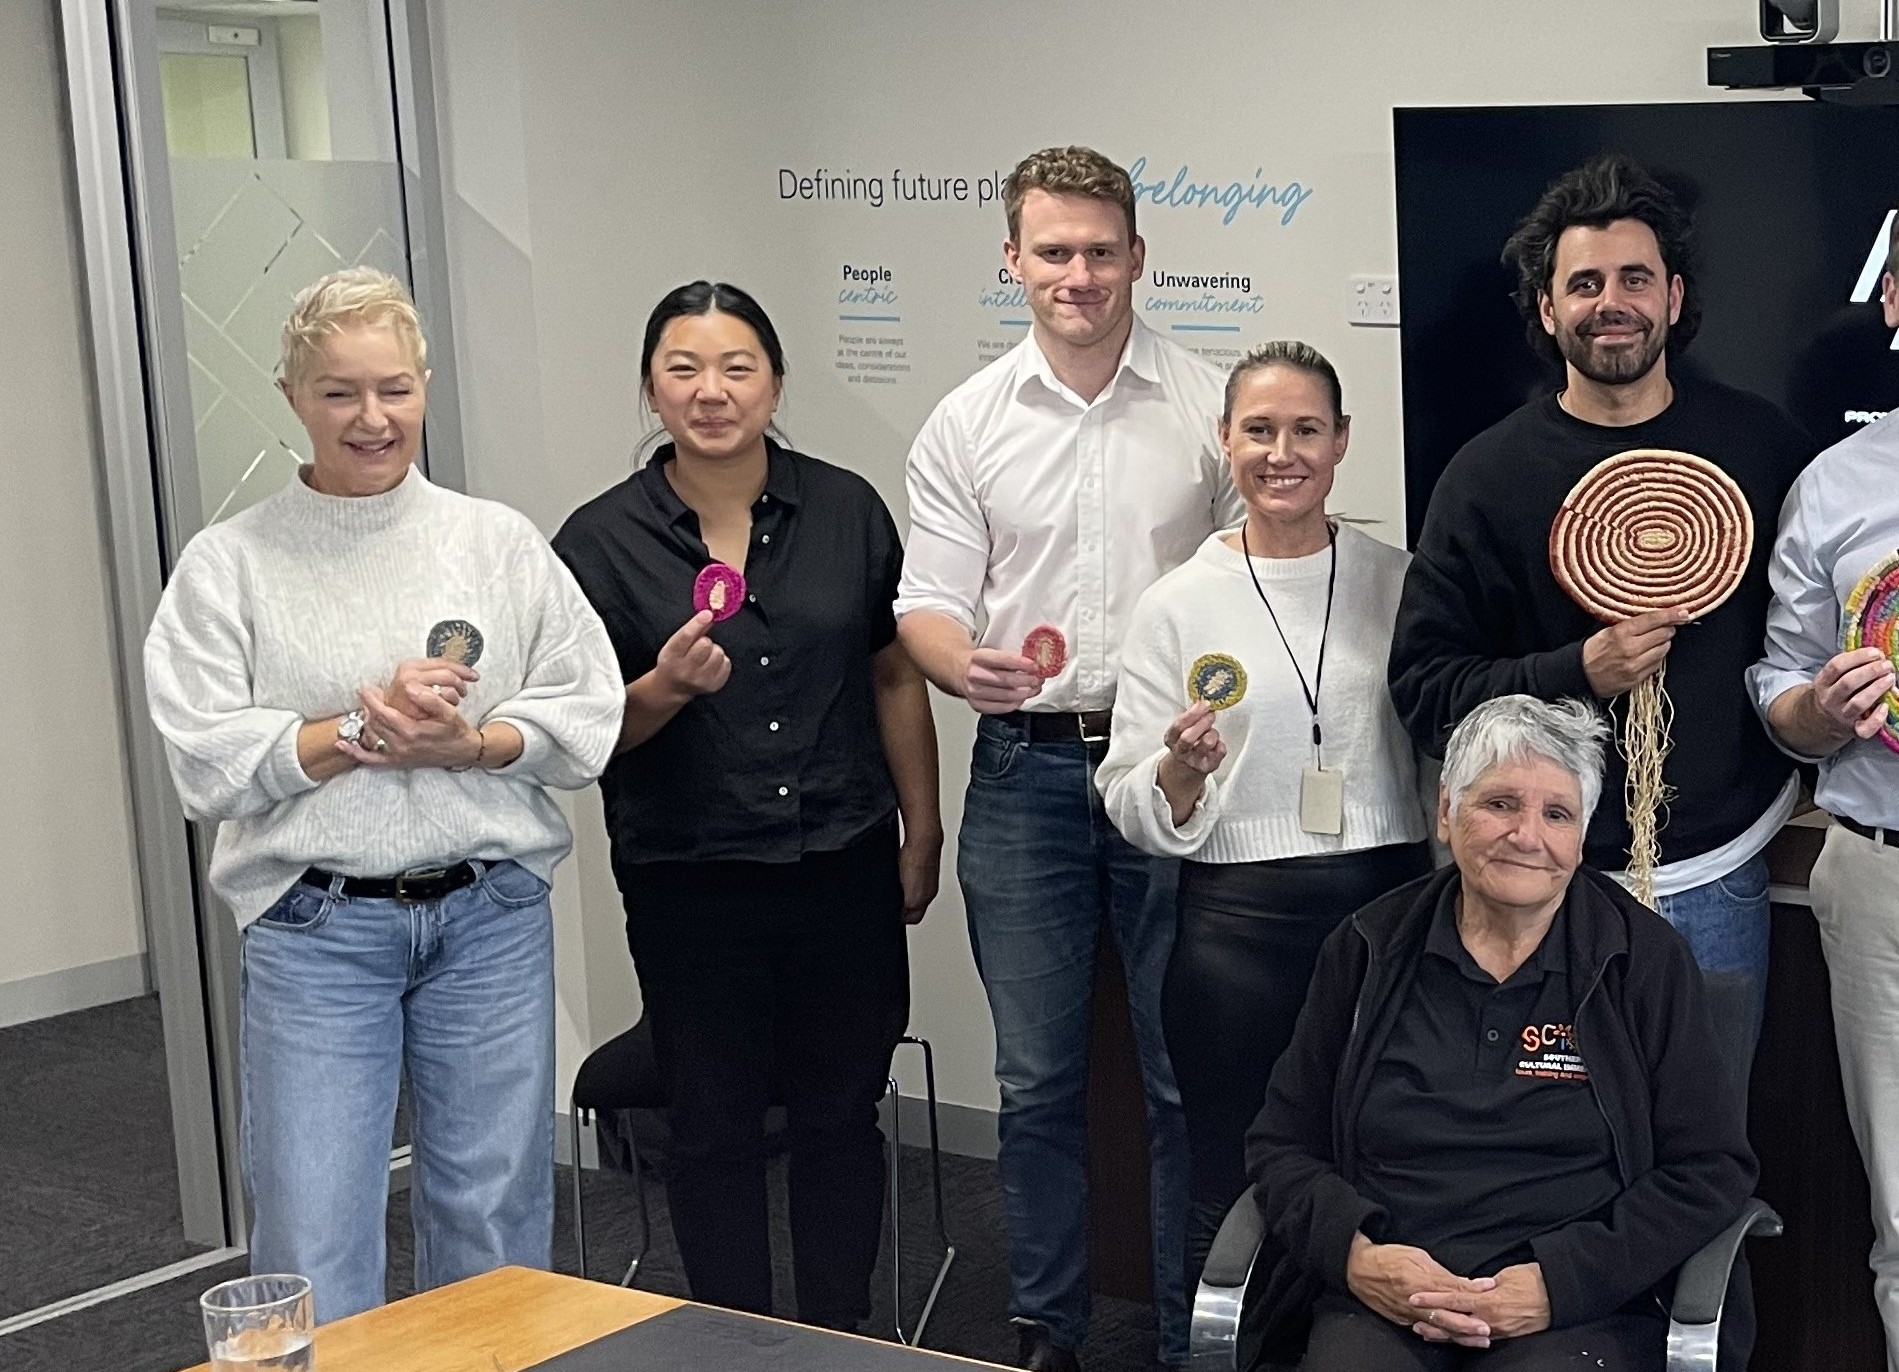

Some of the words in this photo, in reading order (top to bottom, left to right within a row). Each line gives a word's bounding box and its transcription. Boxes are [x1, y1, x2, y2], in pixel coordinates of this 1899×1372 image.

[779, 168, 884, 208] Defining
[892, 168, 969, 201] future
[1128, 156, 1314, 226] belonging
[843, 265, 893, 285] People
[1153, 271, 1251, 293] Unwavering
[838, 286, 898, 305] centric
[979, 287, 1028, 308] intell
[1144, 292, 1264, 314] commitment
[1519, 1061, 1563, 1071] CULTURAL
[1543, 1053, 1582, 1063] SOUTHER
